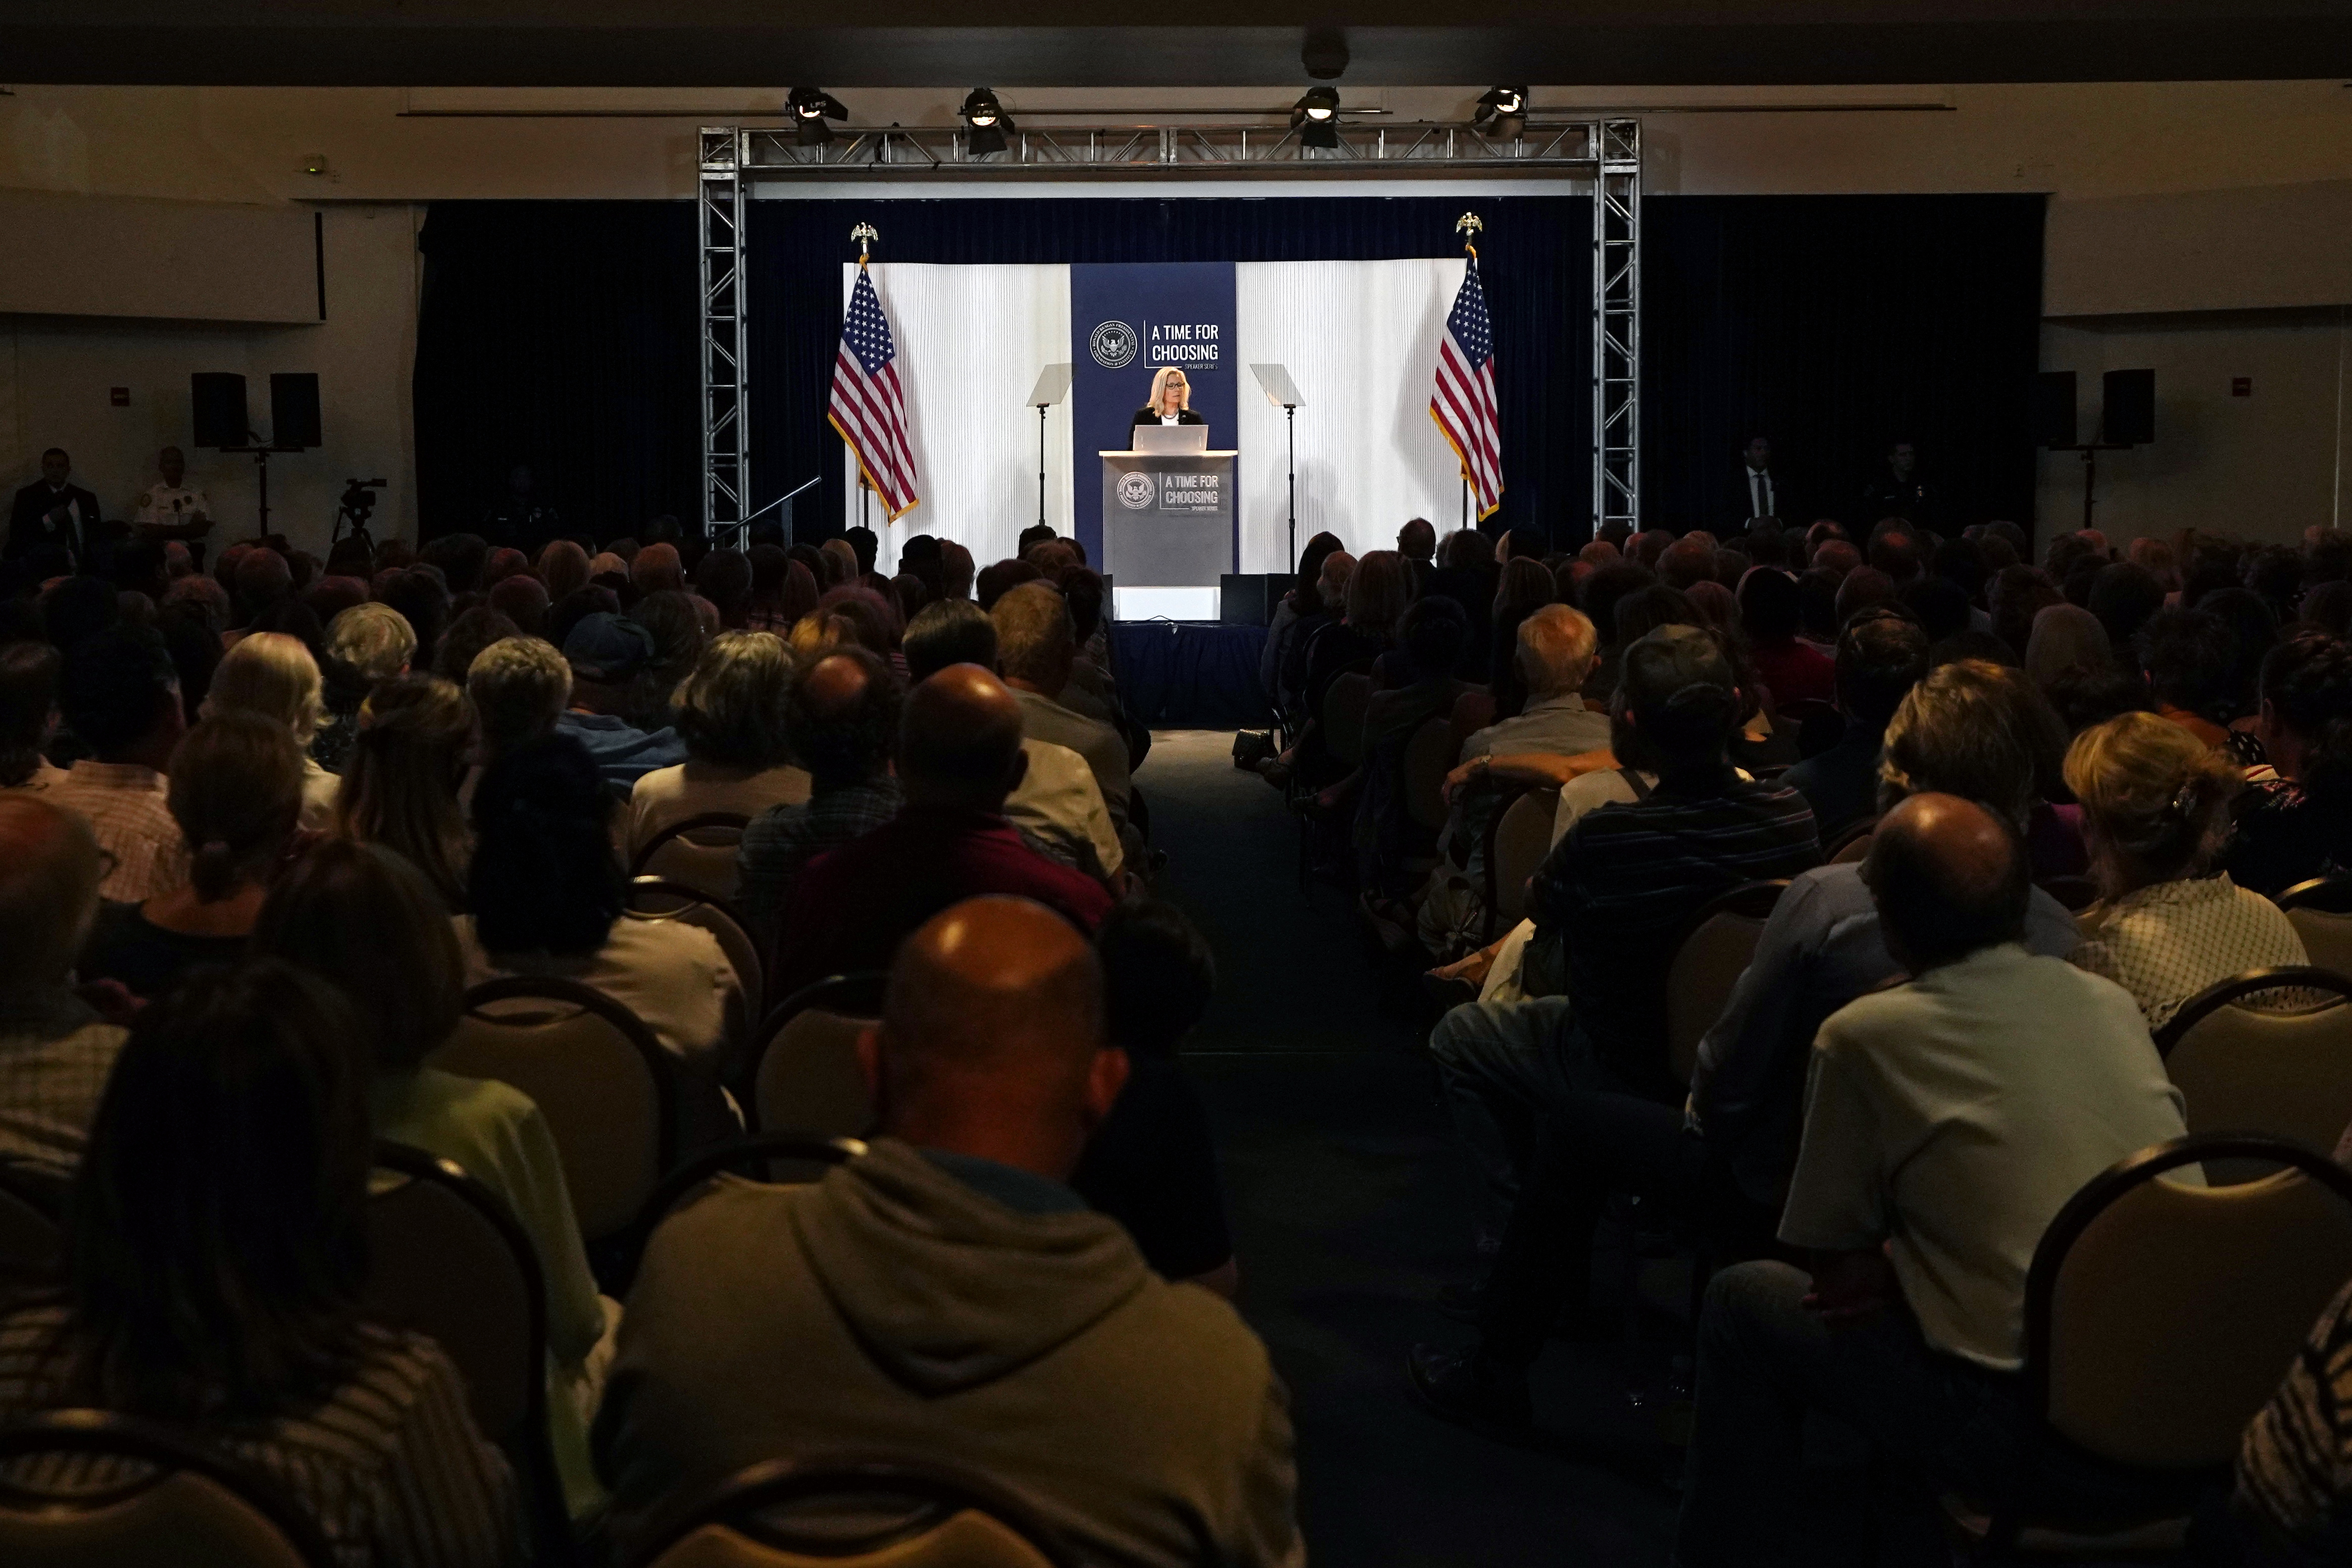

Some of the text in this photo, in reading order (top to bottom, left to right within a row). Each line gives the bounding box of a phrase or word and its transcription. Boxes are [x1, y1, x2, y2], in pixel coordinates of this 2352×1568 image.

[1152, 324, 1219, 340] A TIME FOR
[1152, 344, 1219, 361] CHOOSING
[1165, 475, 1173, 488] A
[1175, 475, 1197, 488] TIME
[1200, 475, 1219, 488] FOR
[1165, 491, 1218, 504] CHOOSING
